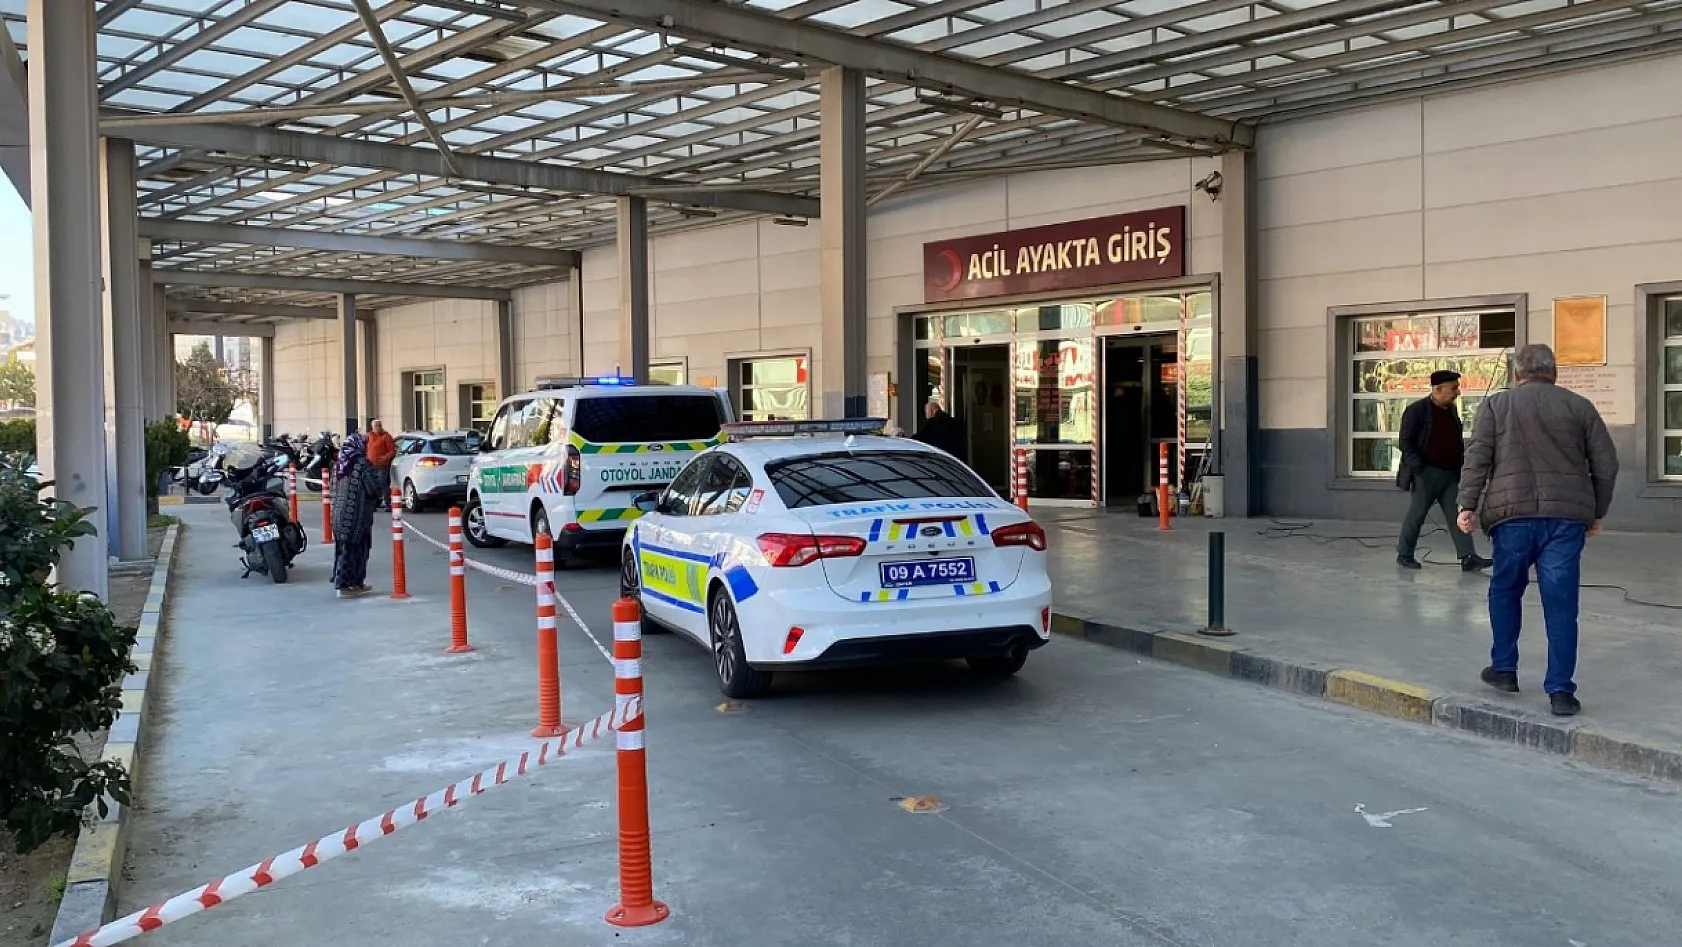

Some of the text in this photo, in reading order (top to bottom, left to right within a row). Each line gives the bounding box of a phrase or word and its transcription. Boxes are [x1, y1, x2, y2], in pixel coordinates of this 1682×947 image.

[967, 221, 1172, 281] ACİL AYAKTA GİRİŞ
[600, 468, 646, 483] OTOYOL
[826, 503, 914, 518] TRAFİK
[889, 561, 968, 581] 09 A 7552
